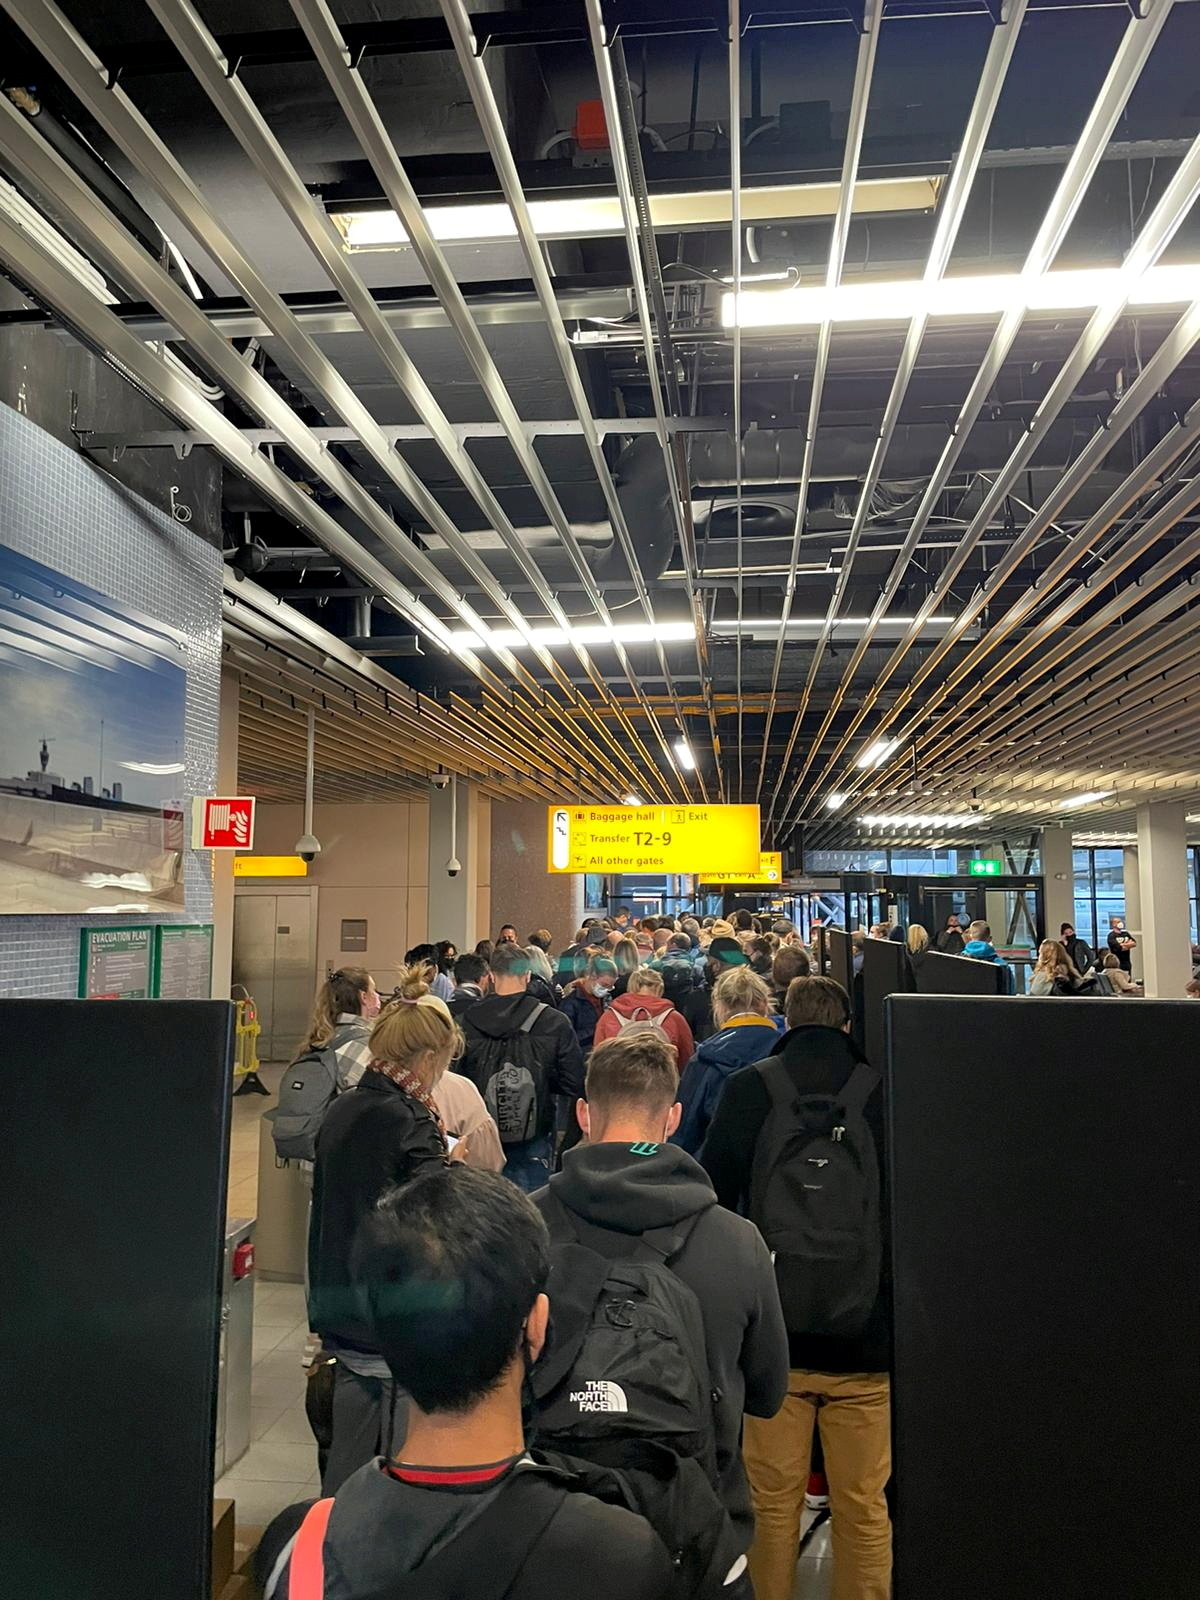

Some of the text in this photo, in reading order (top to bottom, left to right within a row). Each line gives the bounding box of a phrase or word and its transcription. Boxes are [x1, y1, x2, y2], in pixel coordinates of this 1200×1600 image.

[590, 812, 655, 822] Baggage hall
[688, 812, 708, 821] Exit
[590, 831, 672, 846] Transfer T2-9
[590, 856, 664, 867] All other gates
[92, 930, 147, 943] EVACUATION PLAN
[585, 1380, 608, 1391] THE
[569, 1391, 607, 1402] NORTH
[579, 1401, 608, 1412] FACE
